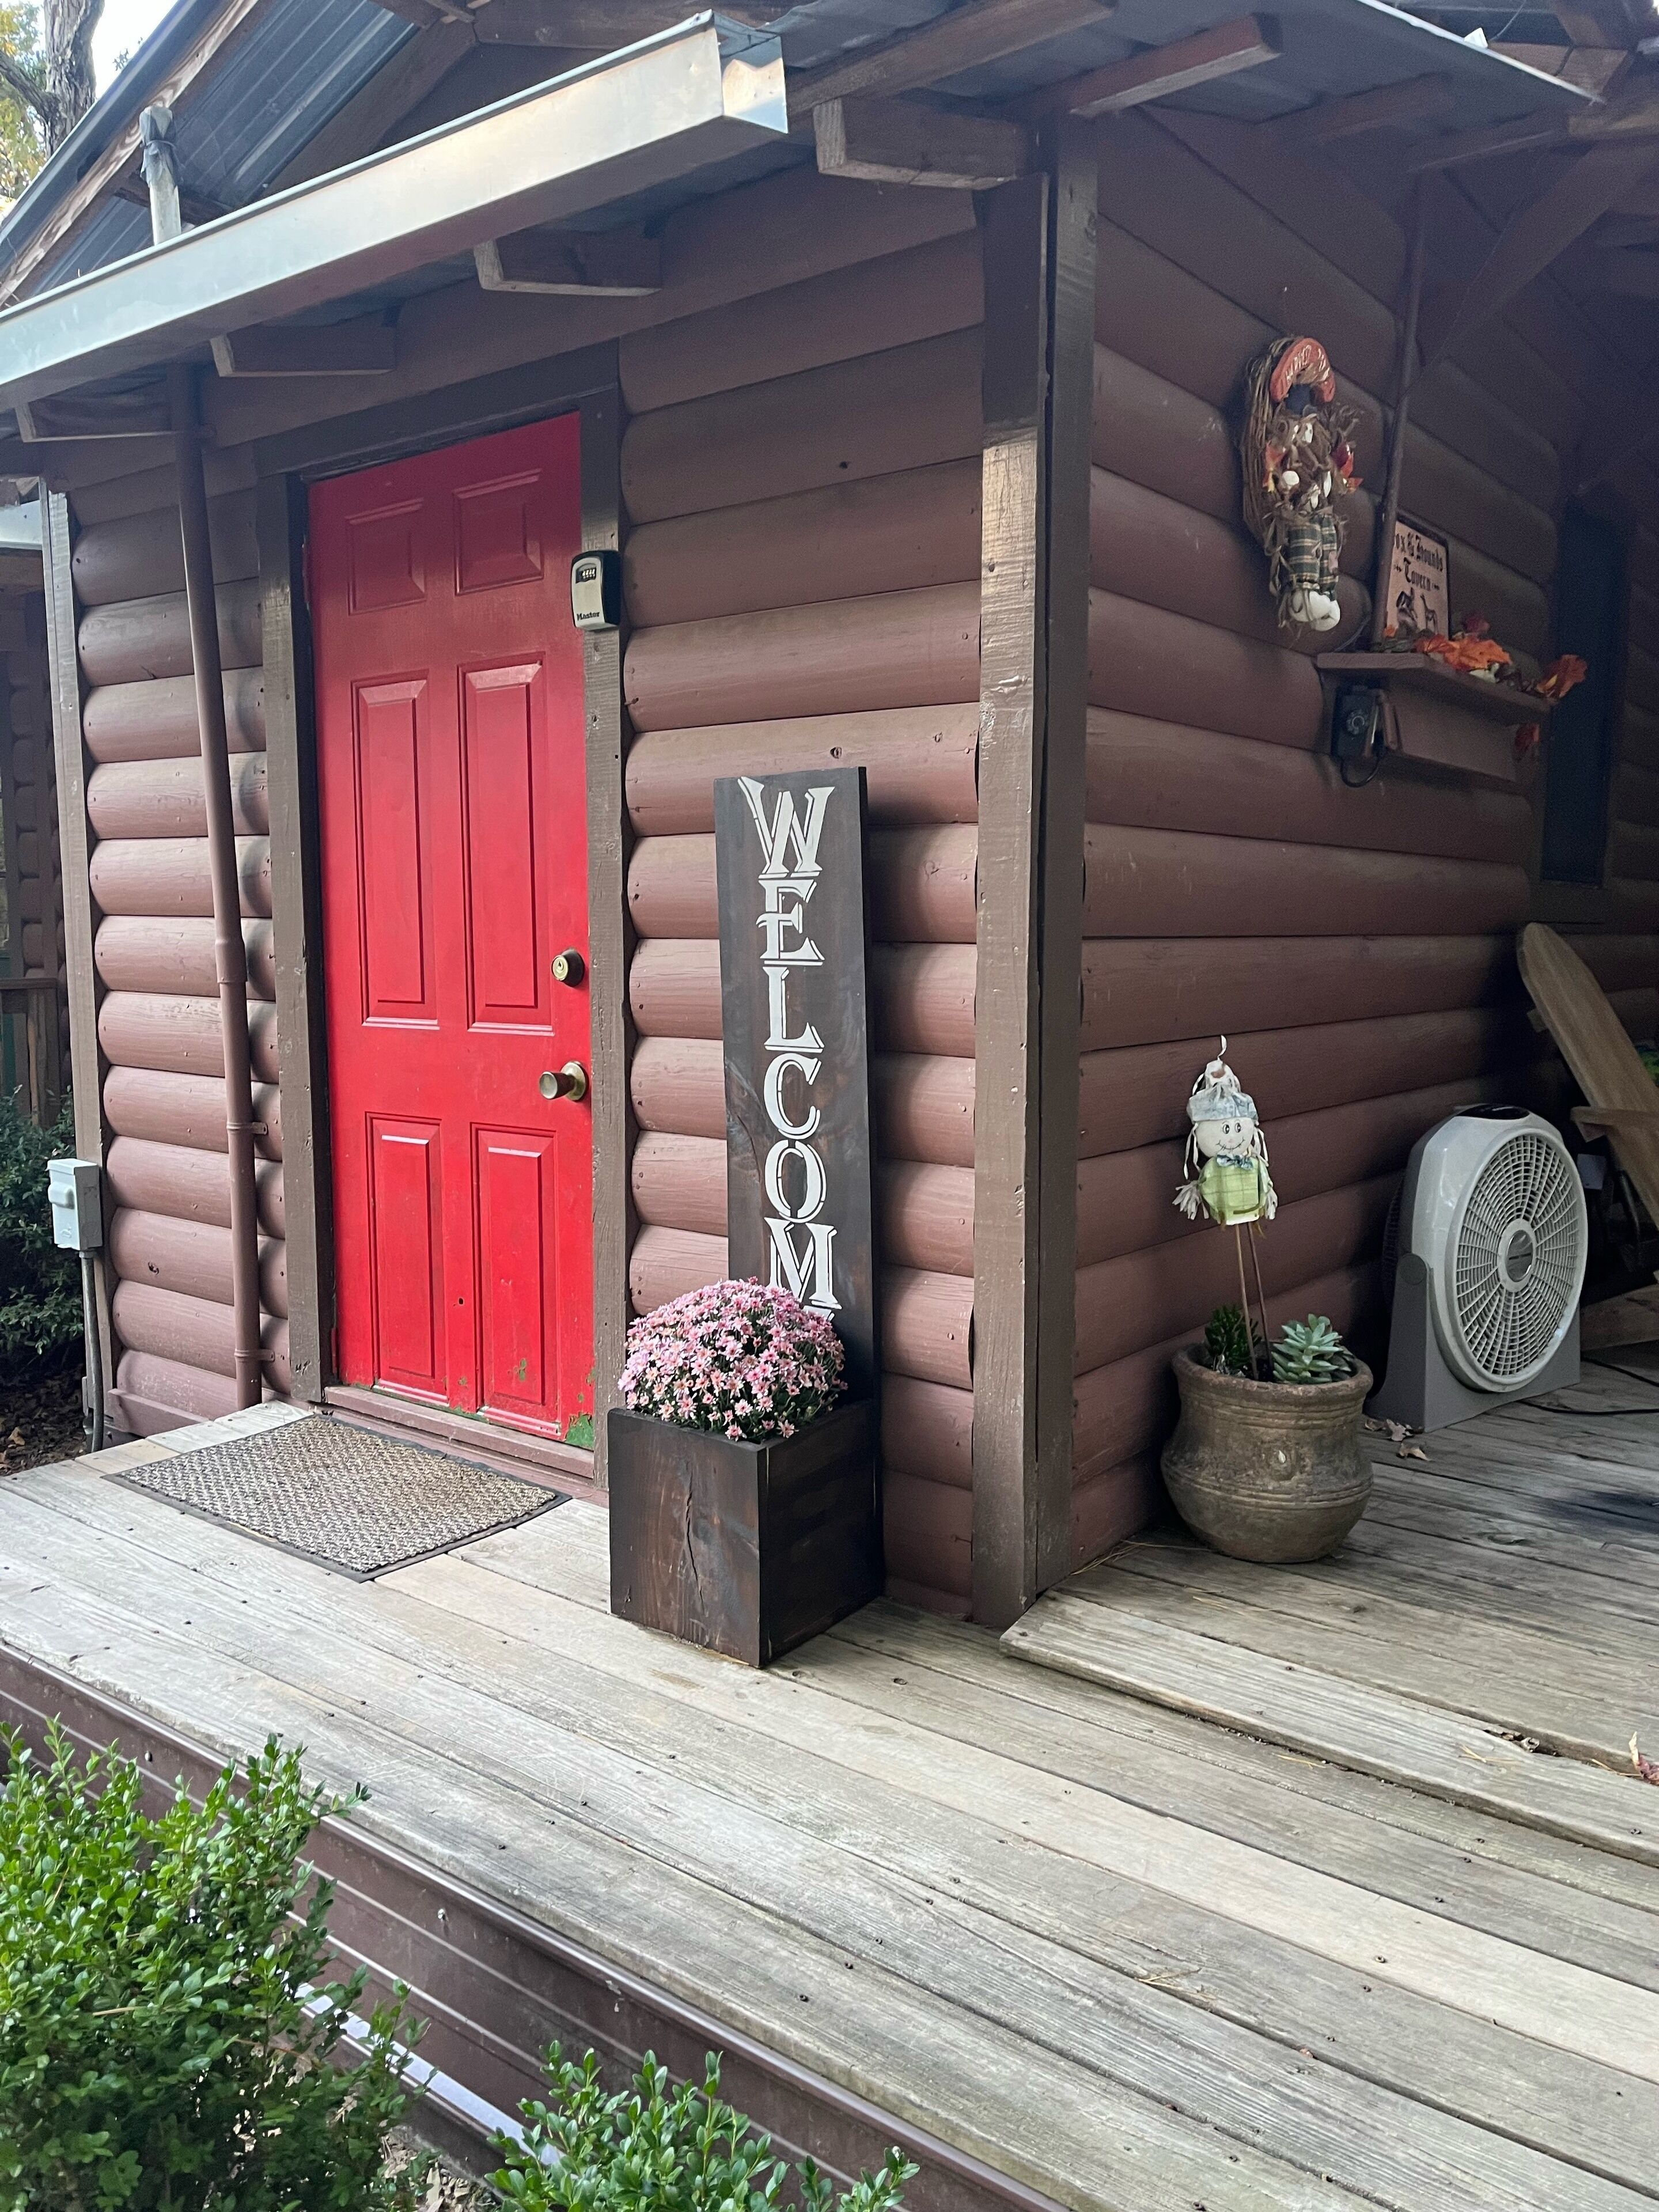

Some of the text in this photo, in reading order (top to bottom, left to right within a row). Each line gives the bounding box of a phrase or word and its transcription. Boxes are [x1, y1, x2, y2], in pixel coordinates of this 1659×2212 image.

[1396, 533, 1406, 554] ox
[576, 611, 600, 621] Master
[737, 776, 843, 1322] WELCOM
